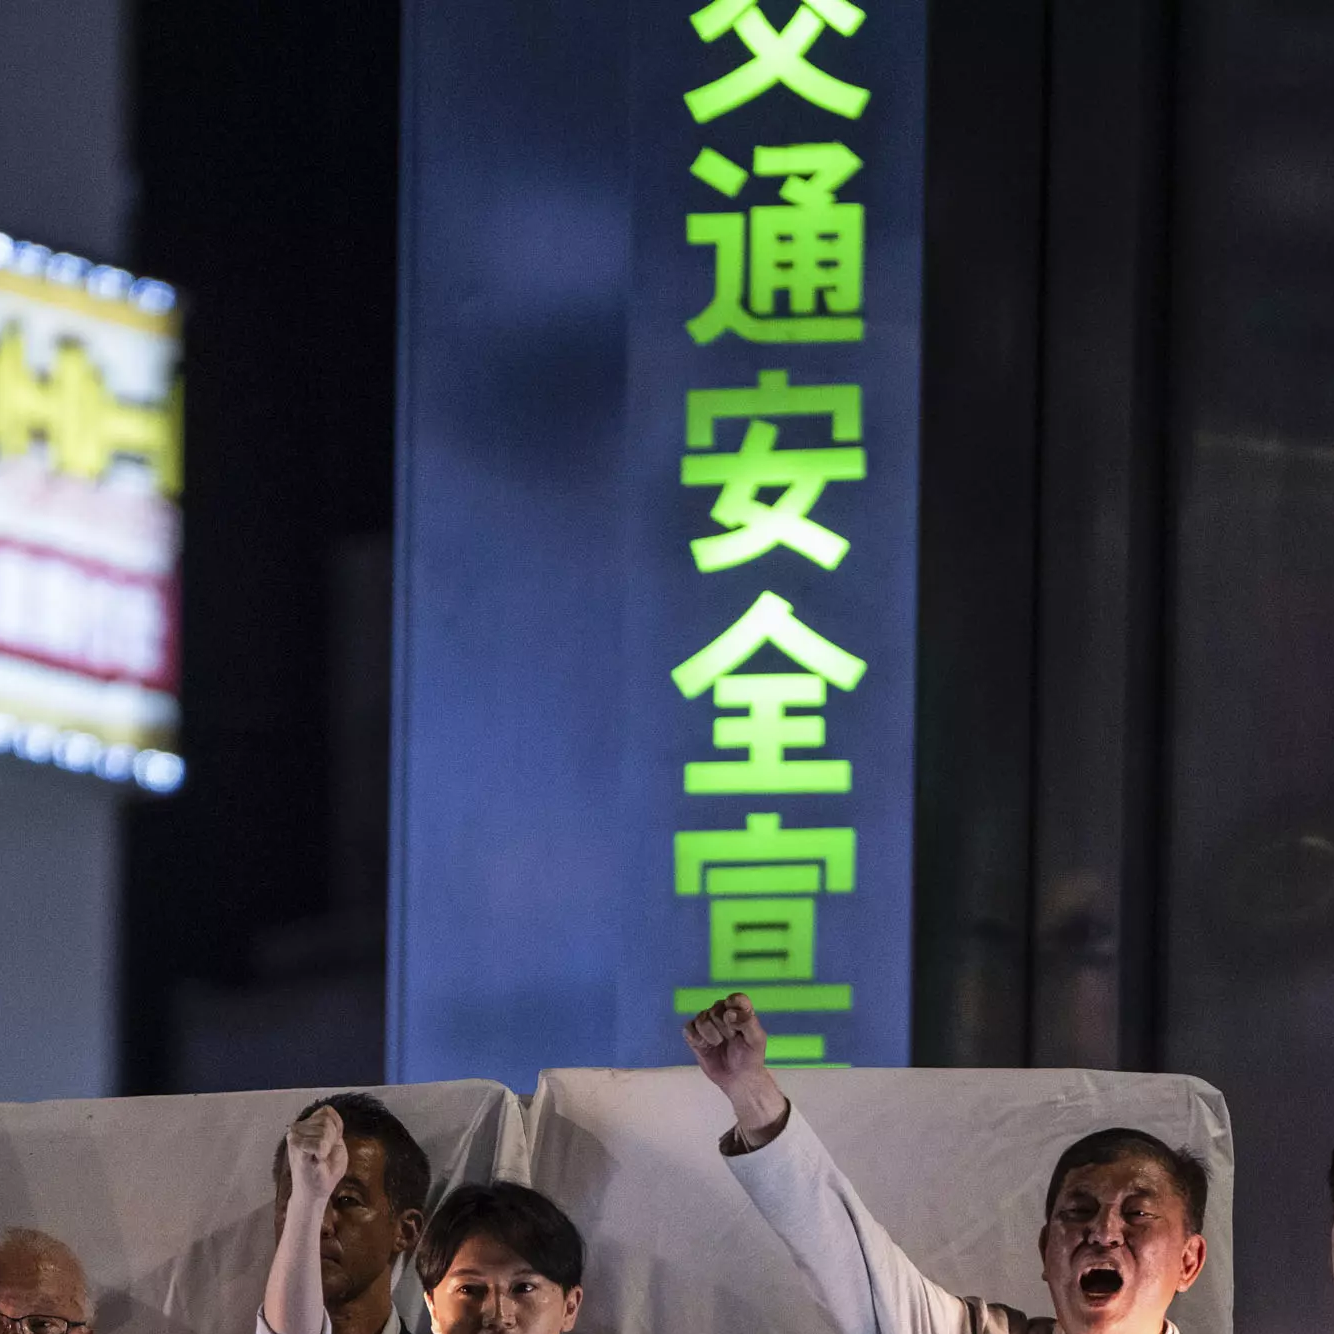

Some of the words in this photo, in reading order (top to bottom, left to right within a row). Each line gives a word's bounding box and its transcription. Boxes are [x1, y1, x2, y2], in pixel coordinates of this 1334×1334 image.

[671, 0, 871, 1068] 交通安全宣
